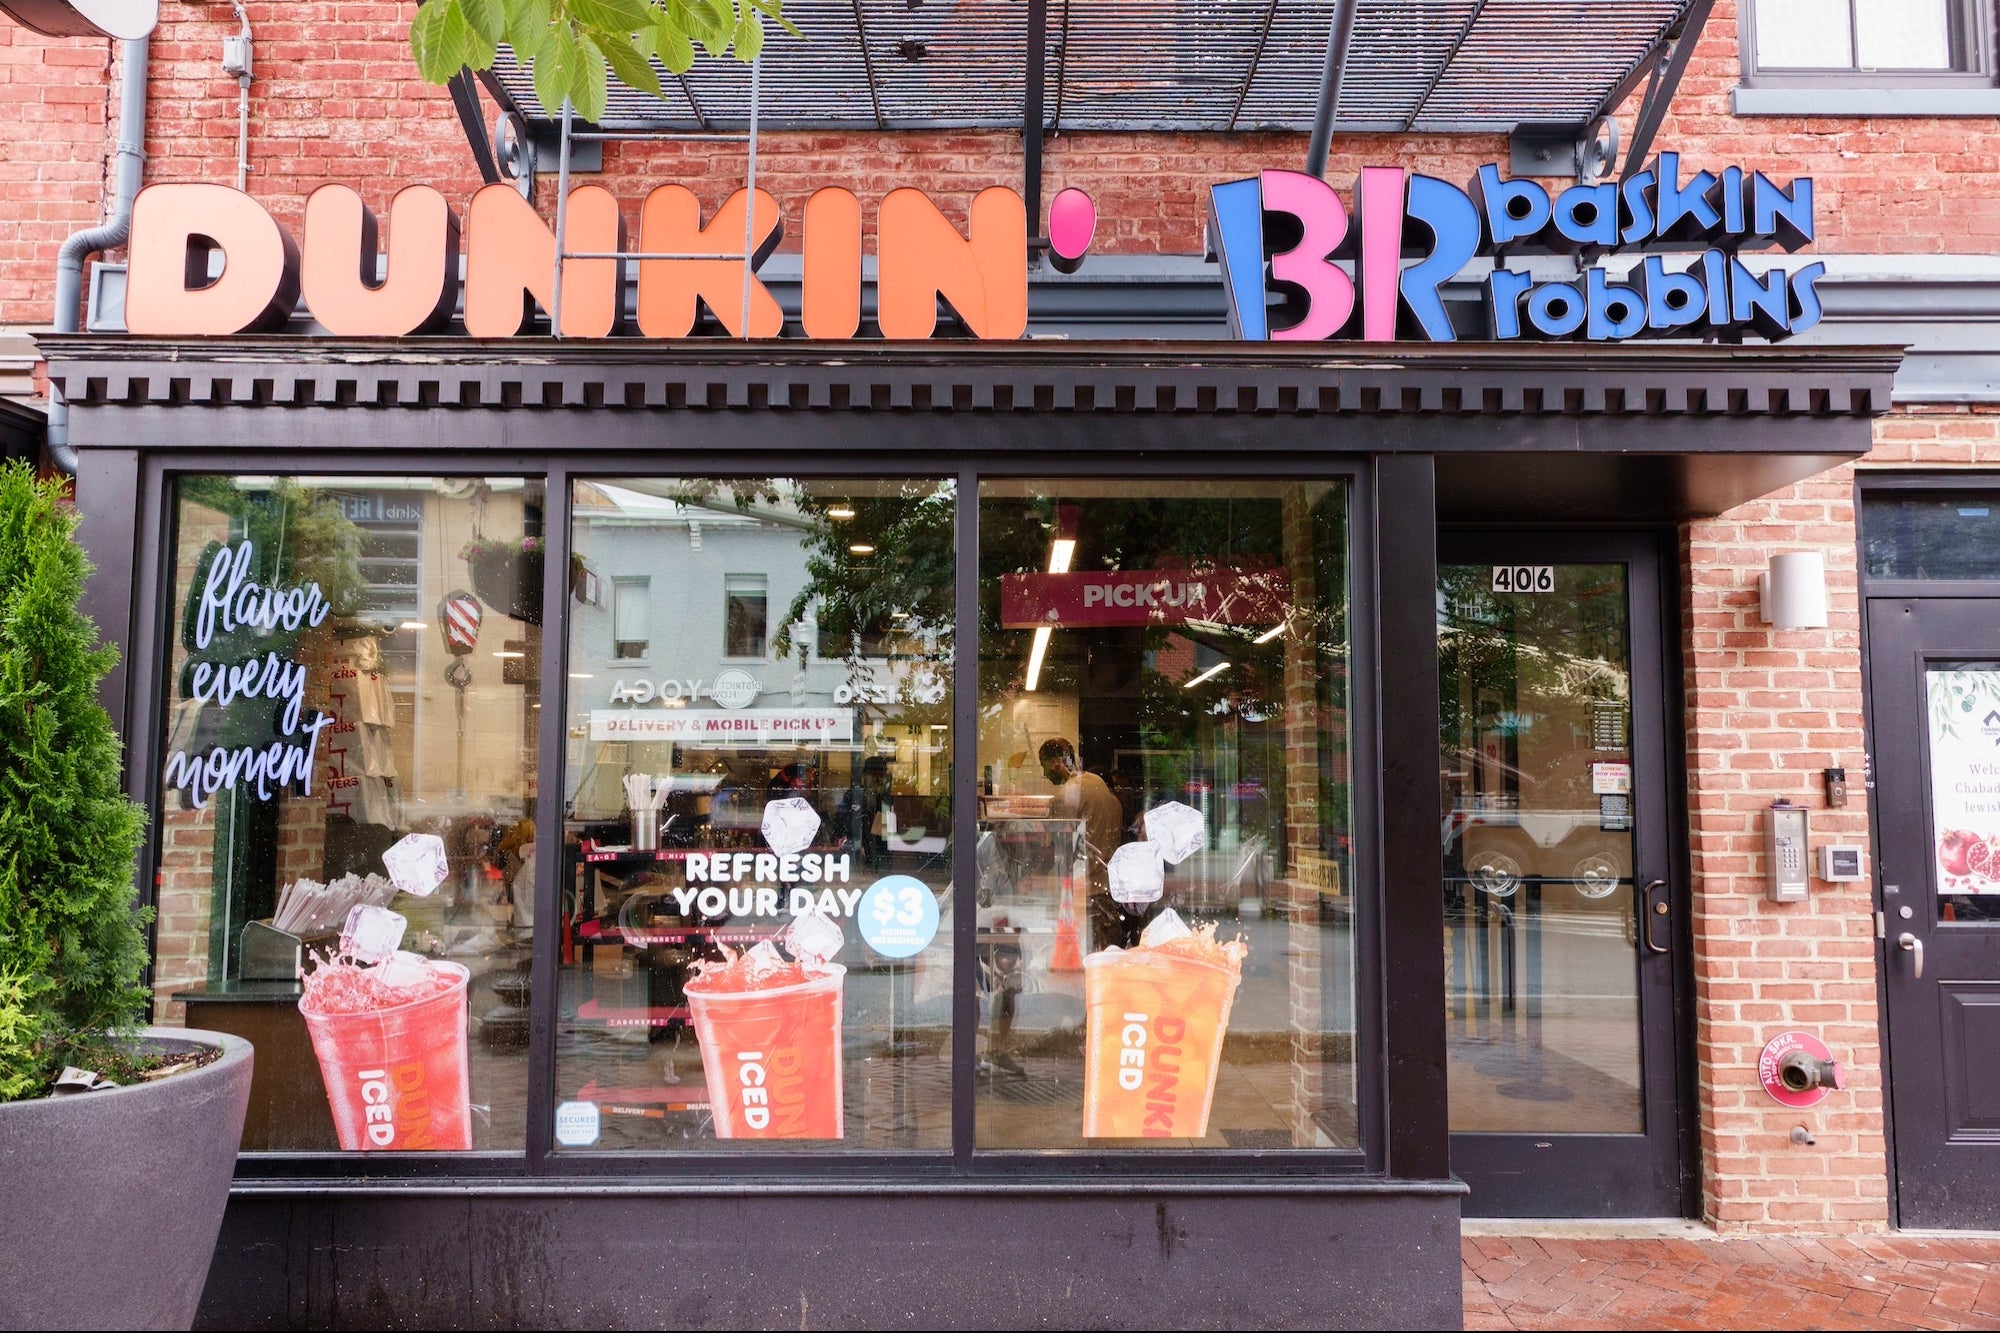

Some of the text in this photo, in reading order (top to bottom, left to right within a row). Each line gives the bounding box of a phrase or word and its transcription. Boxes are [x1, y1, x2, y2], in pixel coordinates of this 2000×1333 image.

[125, 182, 1098, 340] DUNKIN'
[1209, 165, 1482, 342] BR
[195, 540, 332, 650] flavor
[1083, 582, 1208, 608] PICK UP
[1494, 567, 1552, 591] 406
[192, 650, 307, 738] every
[606, 718, 837, 732] DELIVERY & MOBILE PICK UP
[166, 711, 336, 810] moment
[672, 887, 862, 918] YOUR DAY
[685, 852, 850, 883] REFRESH
[872, 886, 925, 926] $3
[1118, 1012, 1149, 1091] ICED
[357, 1069, 395, 1146] ICED
[391, 1060, 434, 1150] DUN
[558, 1116, 596, 1124] SECURED
[612, 1106, 646, 1115] DELIVERY
[686, 1103, 713, 1111] DELIVE
[736, 1051, 770, 1130] ICED
[770, 1046, 807, 1138] DUN
